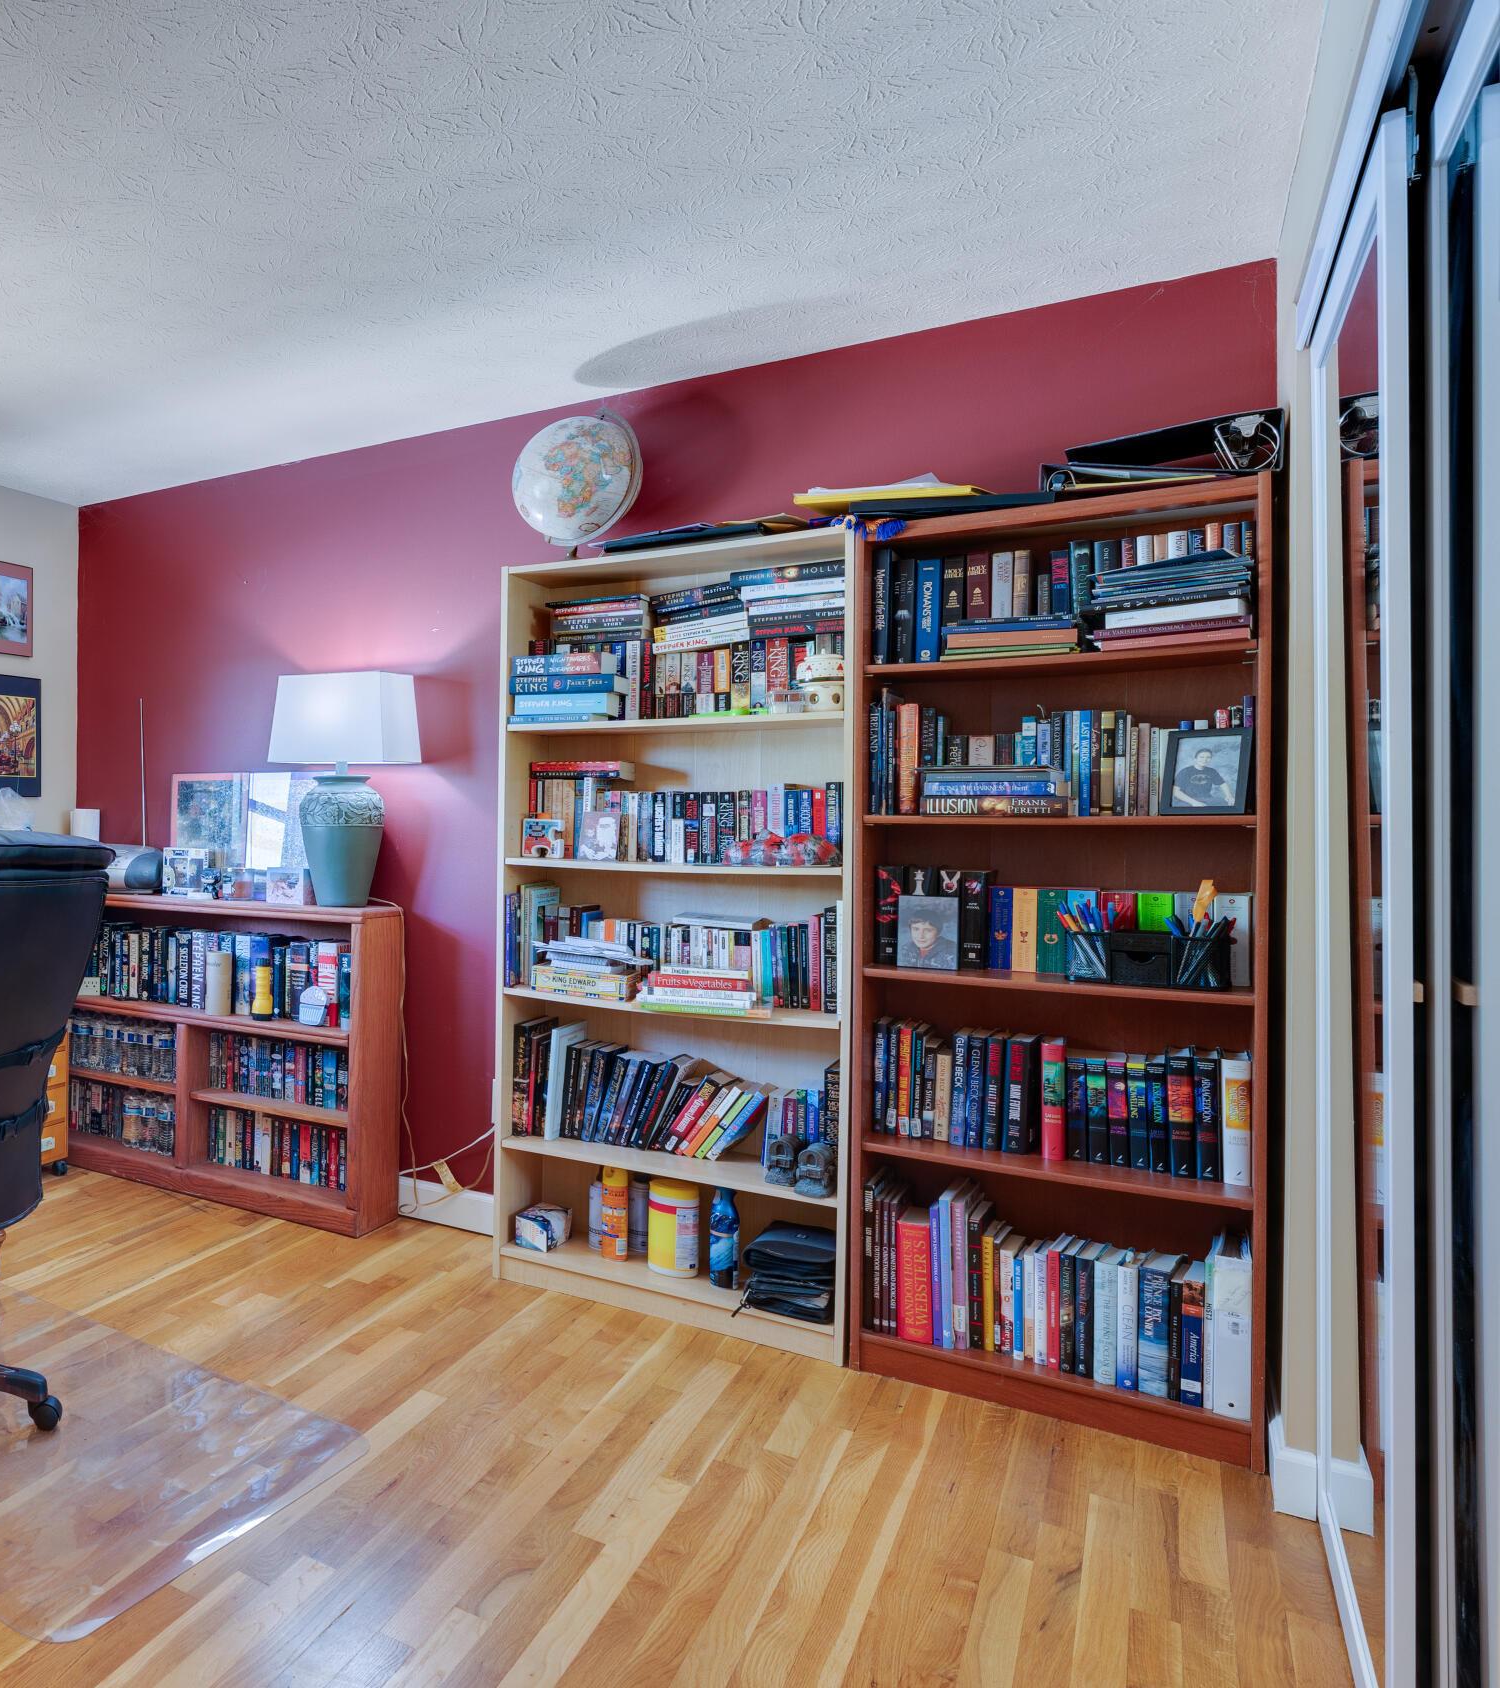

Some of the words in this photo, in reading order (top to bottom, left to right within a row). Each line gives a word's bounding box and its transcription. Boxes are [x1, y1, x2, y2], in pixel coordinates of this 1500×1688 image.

[738, 572, 765, 581] STEPHEN
[803, 564, 839, 575] HOLLY
[968, 564, 987, 572] HOLY
[874, 569, 885, 598] Mysteries
[1079, 564, 1088, 601] HOUSE
[660, 590, 690, 601] STEPHEN
[922, 581, 932, 616] ROMANS
[755, 627, 782, 635] STEPHEN
[784, 625, 805, 633] KING
[875, 615, 885, 631] Bible
[1111, 627, 1148, 636] VANISHING
[1148, 624, 1185, 632] CONSCIENCE
[655, 641, 685, 652] STEPHEN
[686, 637, 708, 648] KING
[515, 657, 545, 665] STEPHEN
[517, 664, 544, 674] KING
[550, 655, 592, 664] NIGHTMARES
[733, 651, 743, 682] KING
[768, 648, 780, 678] KING
[515, 683, 548, 693] KING
[566, 679, 586, 690] FAIRY
[588, 678, 603, 686] TALE
[870, 712, 879, 752] IRELAND
[1081, 721, 1090, 738] LAST
[1053, 747, 1061, 759] TOO
[1081, 739, 1090, 763] WORDS
[827, 789, 835, 805] DEAN
[926, 798, 978, 814] ILLUSION
[1011, 798, 1048, 806] FRANK
[654, 803, 664, 831] LUCIFER'S
[827, 805, 835, 828] KOONTZ
[1007, 806, 1051, 814] PERETTI
[654, 832, 664, 856] HAMMER
[179, 947, 188, 979] SKELETON
[192, 931, 203, 980] STEPHEN
[236, 940, 244, 968] KING
[179, 980, 188, 999] CREW
[552, 976, 567, 984] KING
[569, 978, 596, 987] EDWARD
[657, 976, 681, 985] Fruits
[688, 978, 732, 989] Vegetables
[191, 984, 200, 1009] KING
[900, 1034, 910, 1066] SPYGATE
[955, 1037, 964, 1065] GLENN
[971, 1049, 980, 1079] GLENN
[899, 1076, 908, 1088] DAN
[954, 1066, 963, 1088] BECK
[315, 1088, 323, 1105] CELL
[970, 1080, 980, 1100] BECK
[988, 1084, 997, 1099] GREAT
[1009, 1084, 1021, 1099] DARK
[1171, 1079, 1182, 1121] REMNANT
[1202, 1077, 1211, 1123] ARMAGEDDON
[988, 1101, 997, 1116] RESET
[1008, 1100, 1021, 1121] FUTURE
[1152, 1082, 1163, 1123] DESECRATION
[865, 1190, 873, 1212] TITANIC
[954, 1231, 962, 1259] effects
[903, 1240, 913, 1275] HOUSE
[914, 1240, 928, 1326] WEBSTER'S
[1062, 1266, 1071, 1288] UPPER
[1079, 1271, 1087, 1300] STRANGE
[904, 1277, 914, 1324] RANDOM
[1144, 1281, 1154, 1304] TIDES
[1153, 1275, 1163, 1305] PRINCE
[1079, 1301, 1087, 1316] FIRE
[1153, 1309, 1163, 1323] PAT
[1122, 1304, 1133, 1341] CLEAN
[1144, 1306, 1154, 1337] CONROY
[1189, 1332, 1200, 1364] America
